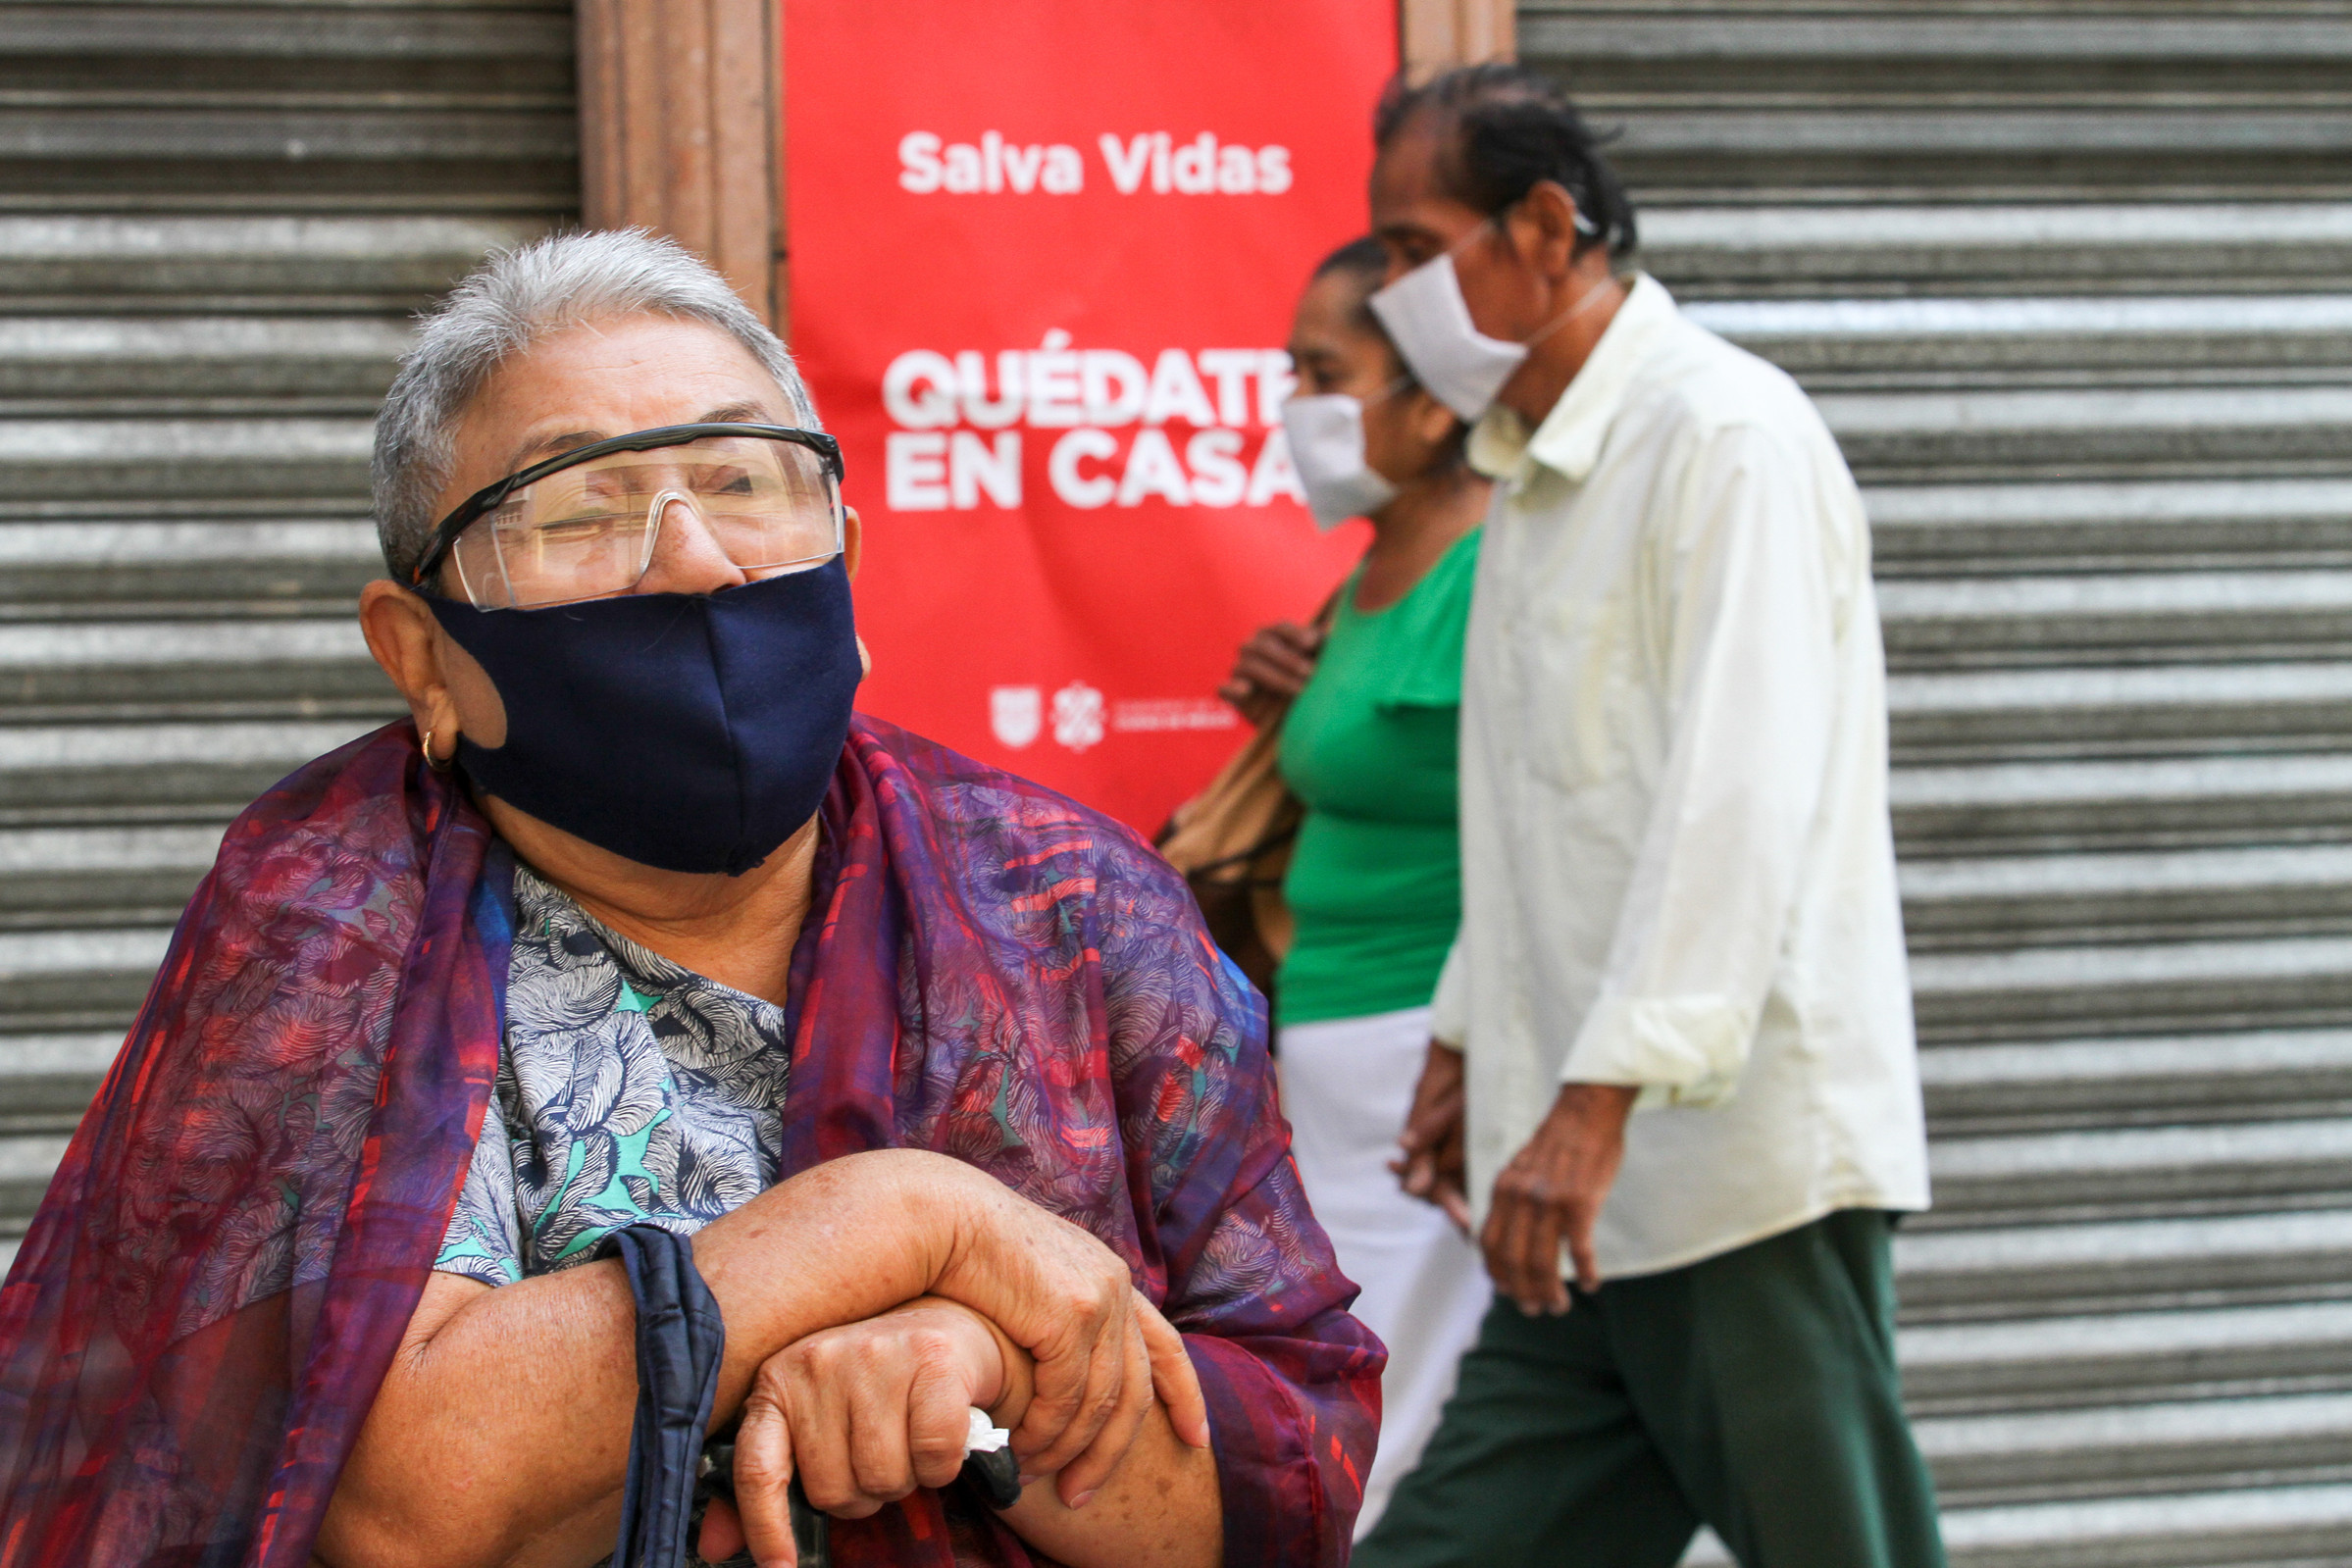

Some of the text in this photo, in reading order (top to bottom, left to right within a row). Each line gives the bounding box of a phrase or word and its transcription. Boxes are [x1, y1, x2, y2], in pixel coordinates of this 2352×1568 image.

[897, 129, 1293, 194] Salva Vidas
[886, 429, 1307, 511] EN CASA
